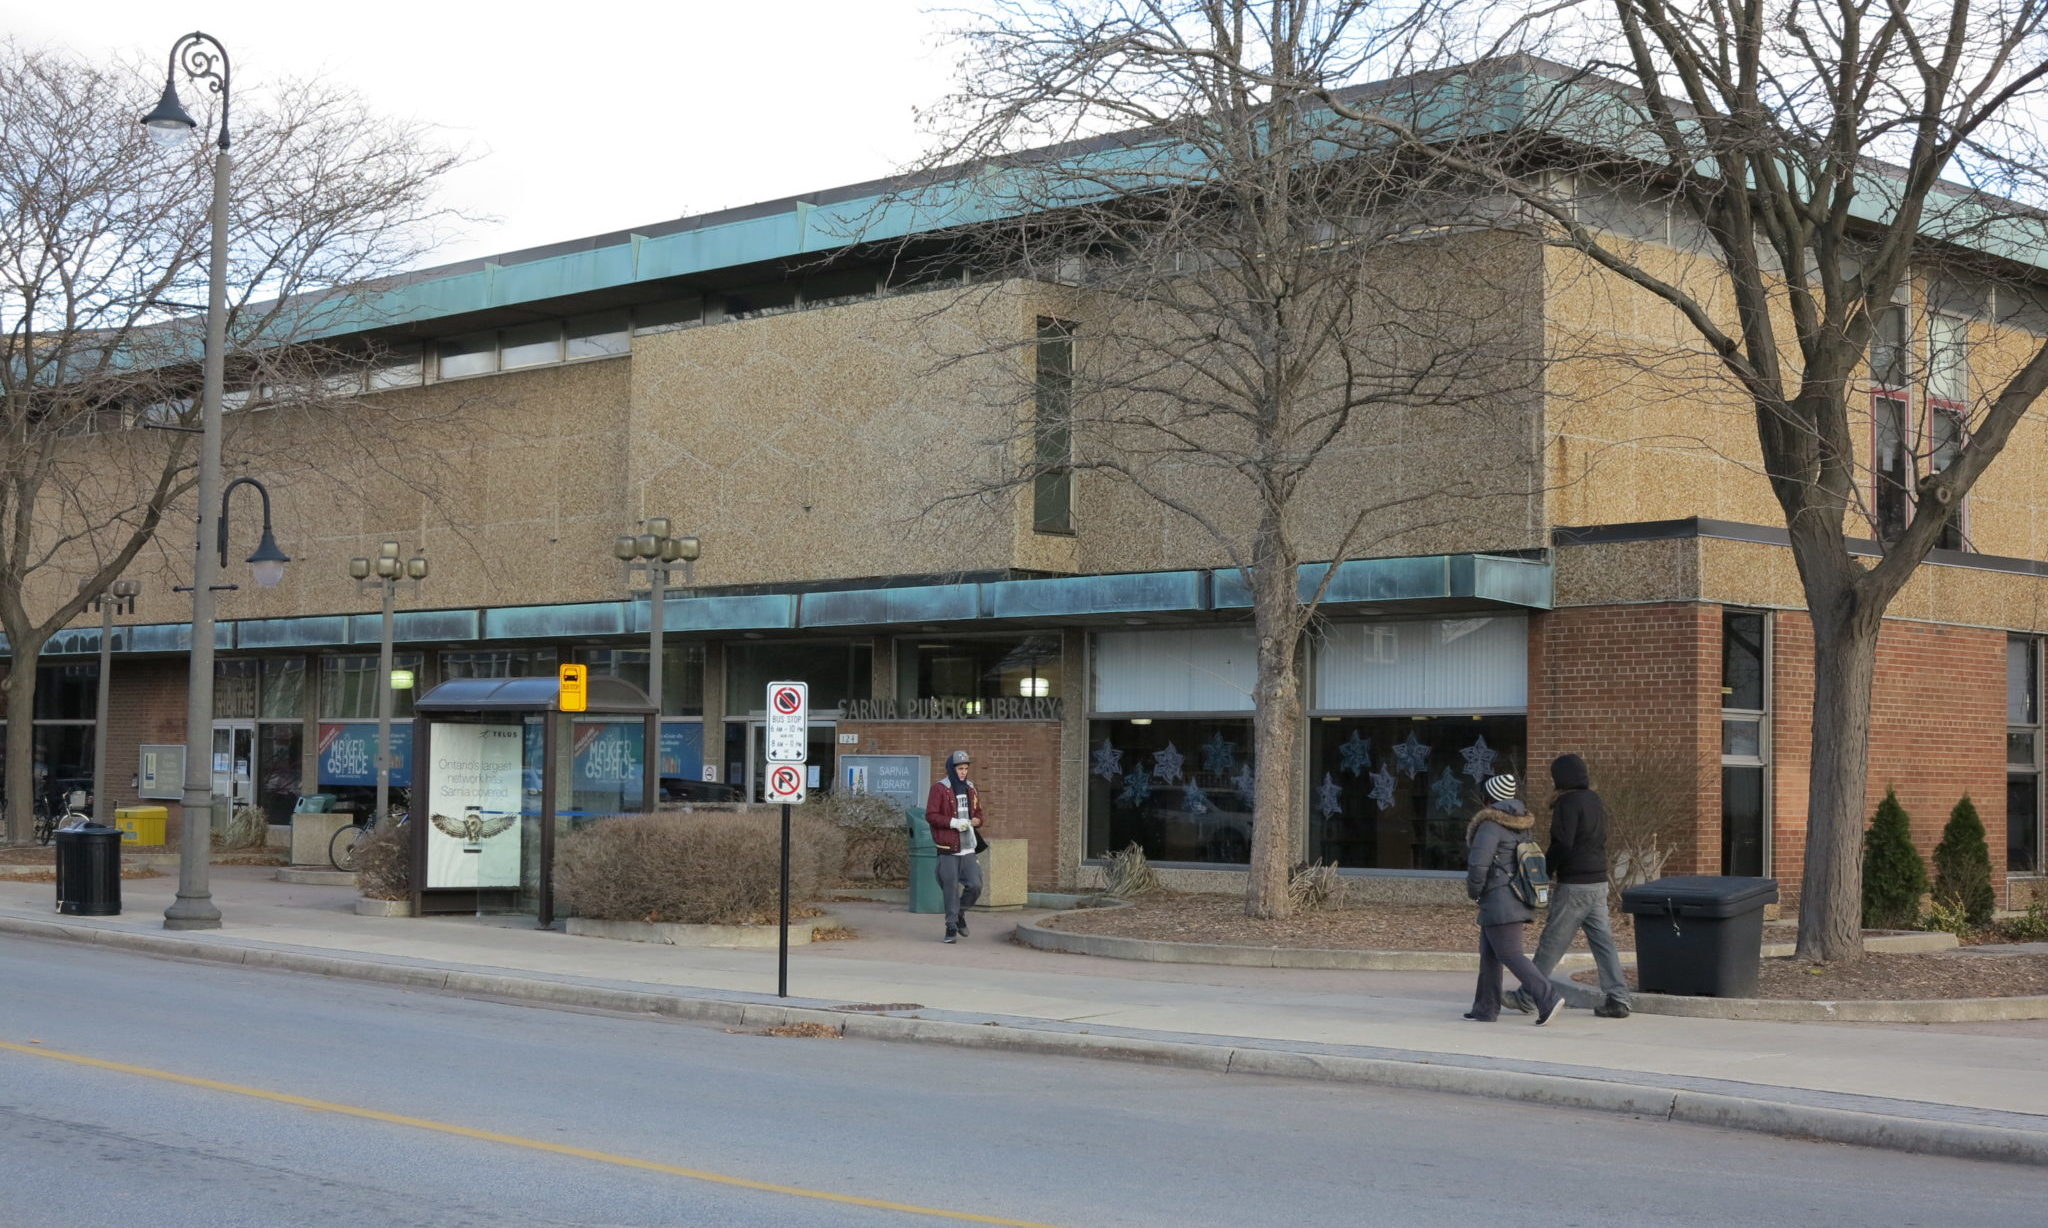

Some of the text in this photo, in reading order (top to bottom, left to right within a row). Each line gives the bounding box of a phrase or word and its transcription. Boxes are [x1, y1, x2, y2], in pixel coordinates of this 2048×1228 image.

[838, 697, 1058, 720] SARNIA PUBLIC LIBRARY
[772, 715, 802, 723] BUS STOP
[842, 733, 856, 741] 124
[331, 740, 366, 758] MAKER
[590, 740, 632, 760] MAKER
[438, 758, 512, 773] Ontario's largest
[879, 766, 910, 776] SARNIA
[447, 774, 484, 784] network
[877, 779, 911, 789] LIBRARY
[440, 785, 470, 797] Sarnia
